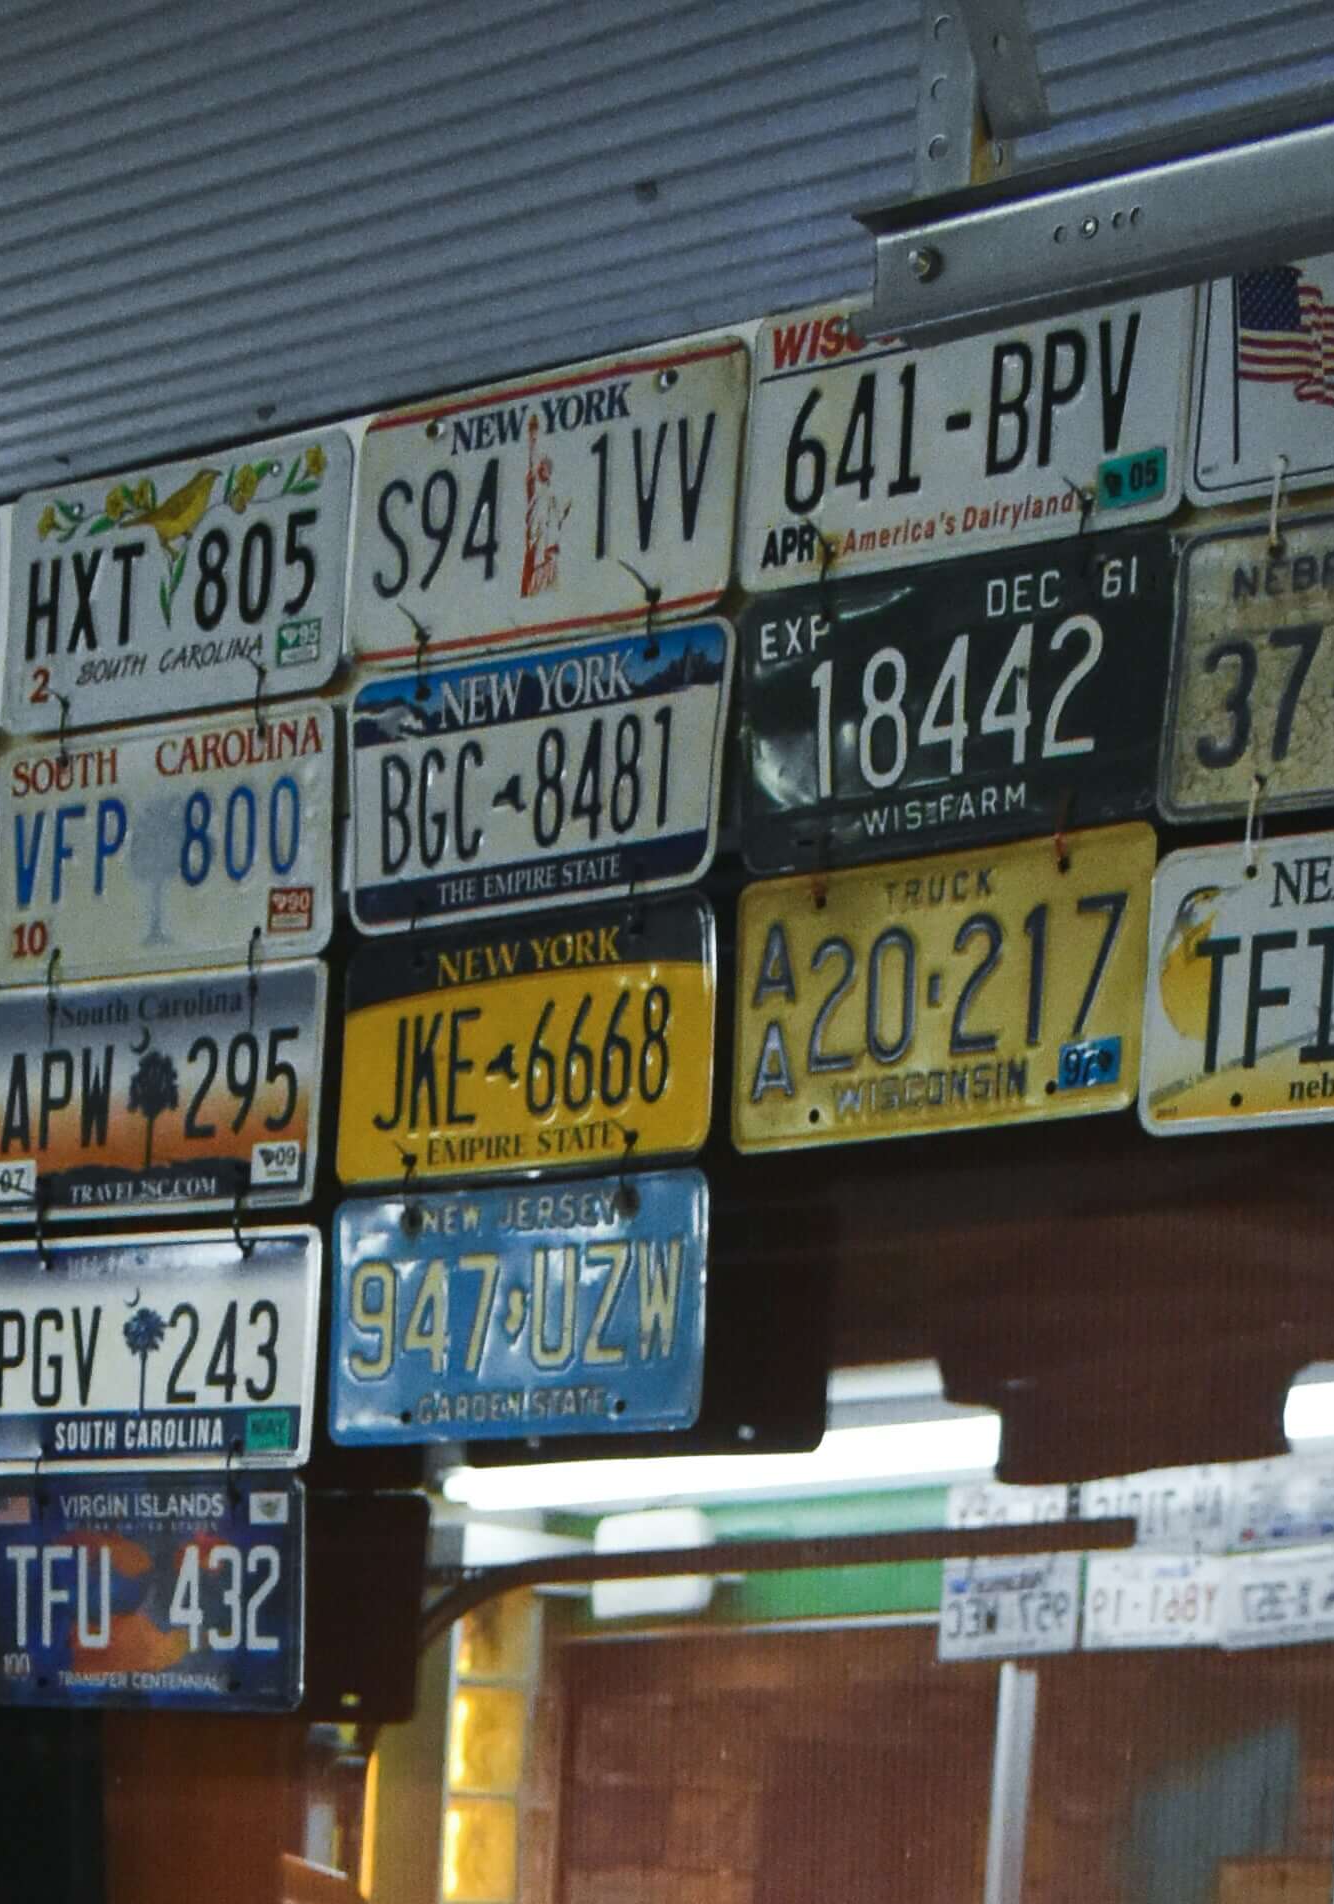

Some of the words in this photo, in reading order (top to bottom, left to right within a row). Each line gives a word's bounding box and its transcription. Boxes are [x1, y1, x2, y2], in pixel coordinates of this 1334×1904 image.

[450, 405, 529, 456] NEW
[539, 381, 633, 435] YORK
[783, 311, 1142, 516] 641-BPV
[372, 457, 501, 600] S94
[590, 411, 717, 561] 1VV
[761, 525, 817, 569] APR
[841, 510, 957, 557] America's
[961, 488, 1080, 535] Dairyland
[1128, 458, 1160, 491] 05
[25, 541, 146, 662] HXT
[194, 508, 317, 632] 805
[759, 613, 830, 661] EXP
[986, 569, 1061, 618] DEC
[1101, 555, 1139, 599] 61
[29, 667, 51, 703] 2
[75, 653, 148, 687] SOUTH
[158, 634, 264, 674] CAROLINA
[439, 666, 526, 730] NEW
[535, 648, 634, 712] YORK
[810, 613, 1105, 799] 18442
[11, 747, 118, 800] SOUTH
[154, 716, 324, 778] CAROLINA
[13, 796, 128, 910] VFP
[180, 775, 301, 888] 800
[438, 881, 478, 906] THE
[482, 865, 557, 898] EMPIRE
[562, 852, 622, 888] STATE
[885, 868, 994, 905] TRUCK
[11, 920, 49, 960] 10
[437, 940, 521, 987] NEW
[530, 926, 621, 970] YORK
[60, 1001, 130, 1029] South
[139, 990, 243, 1022] Carolina
[0, 1045, 115, 1155] APW
[183, 1024, 300, 1141] 295
[833, 1057, 1029, 1113] WISCONSIN
[426, 1132, 526, 1167] EMPIRE
[535, 1119, 616, 1157] STATE
[422, 1205, 481, 1234] NEW
[498, 1188, 619, 1231] JERSEY
[165, 1300, 281, 1404] 243
[55, 1421, 117, 1451] SOUTH
[124, 1416, 225, 1449] CAROLINA
[415, 1393, 525, 1427] GARDEN
[531, 1386, 608, 1418] STATE
[58, 1494, 128, 1518] VIRGIN
[133, 1491, 225, 1518] ISLANDS
[6, 1544, 112, 1650] TFU
[169, 1544, 282, 1652] 432
